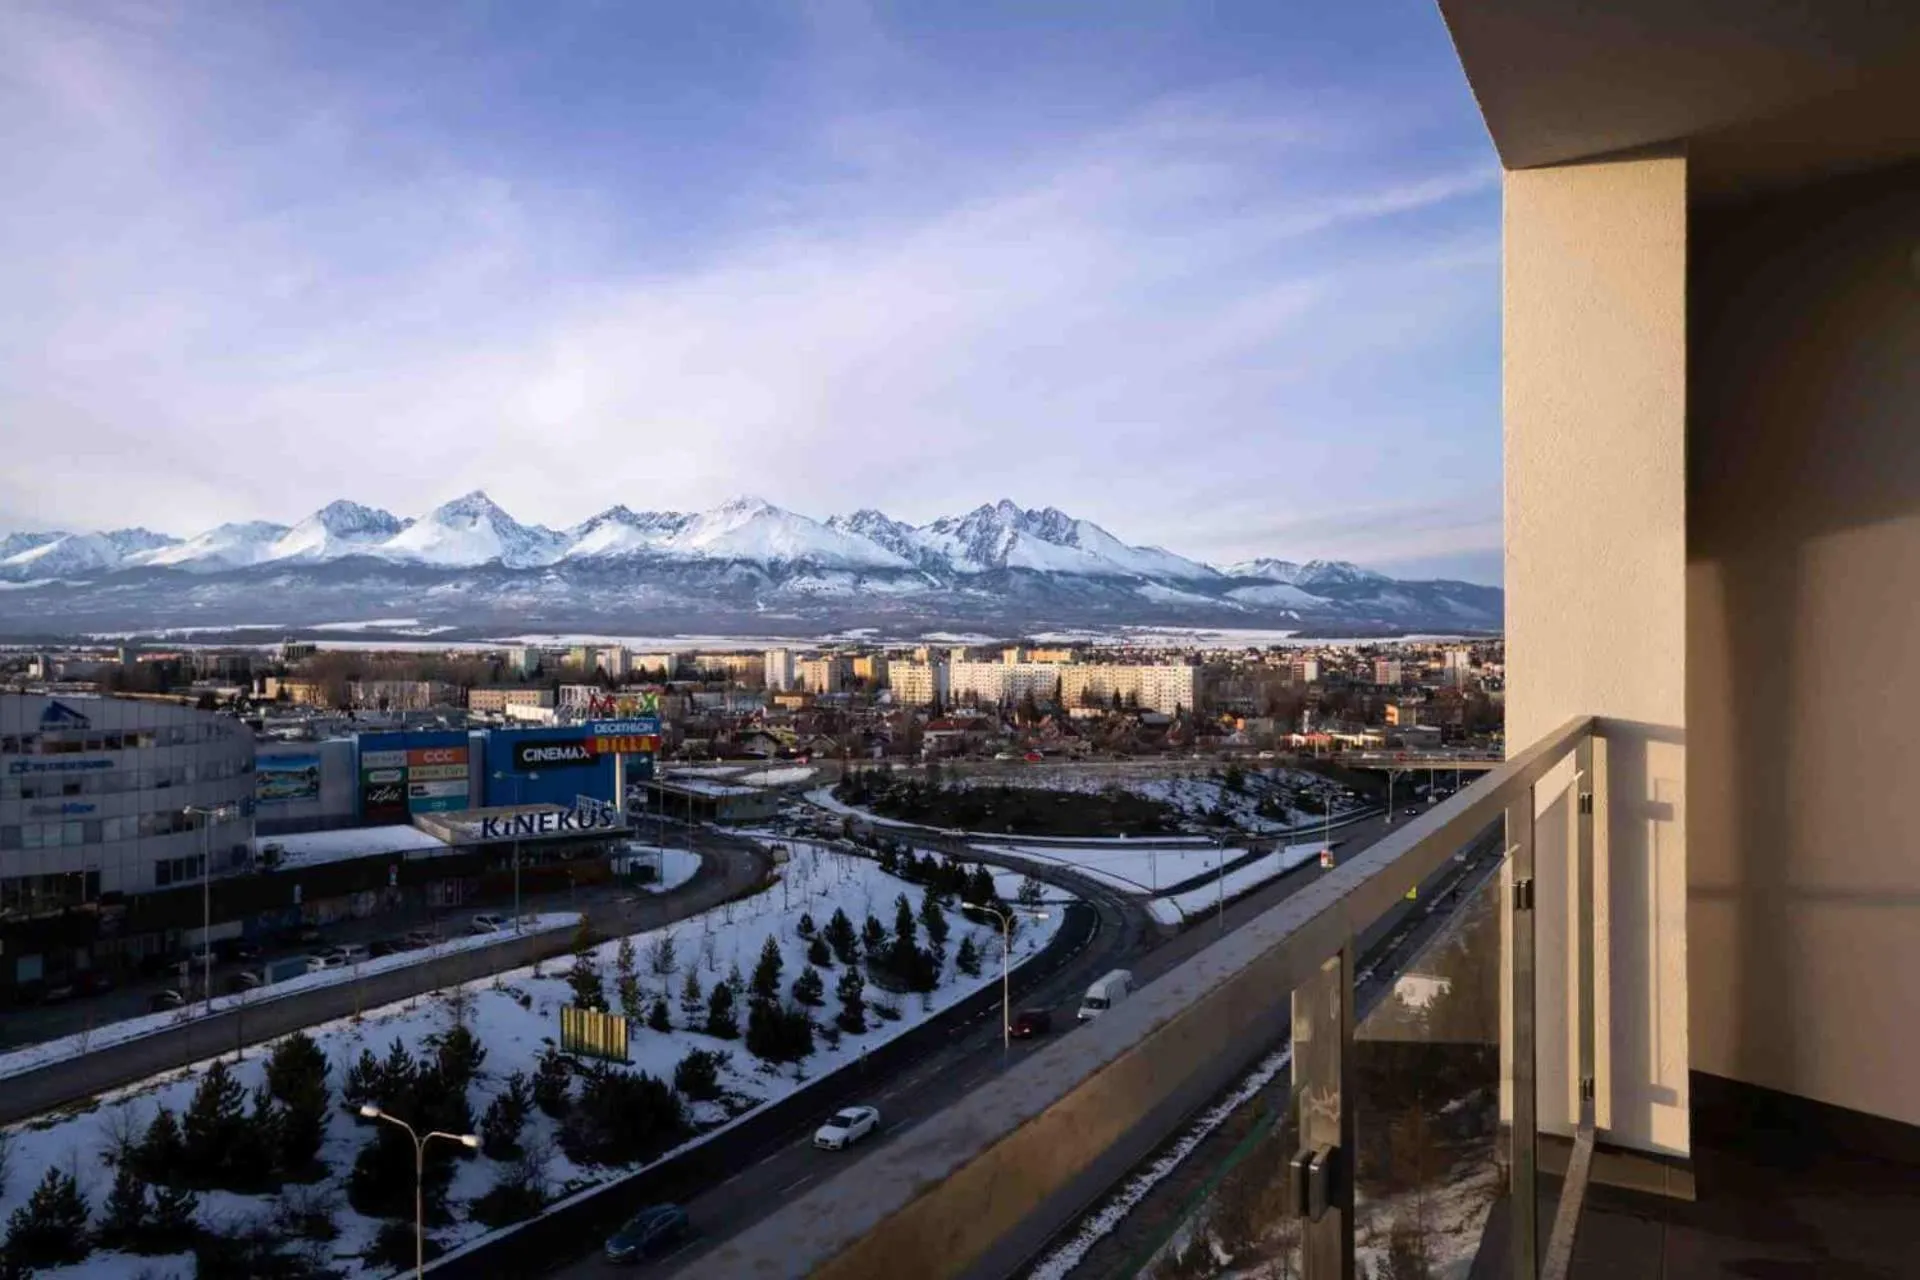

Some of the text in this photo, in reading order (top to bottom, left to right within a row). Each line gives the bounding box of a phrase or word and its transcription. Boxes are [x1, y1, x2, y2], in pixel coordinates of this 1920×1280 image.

[596, 736, 651, 753] BILLA
[423, 749, 453, 764] CCC
[522, 746, 590, 762] CINEMAX
